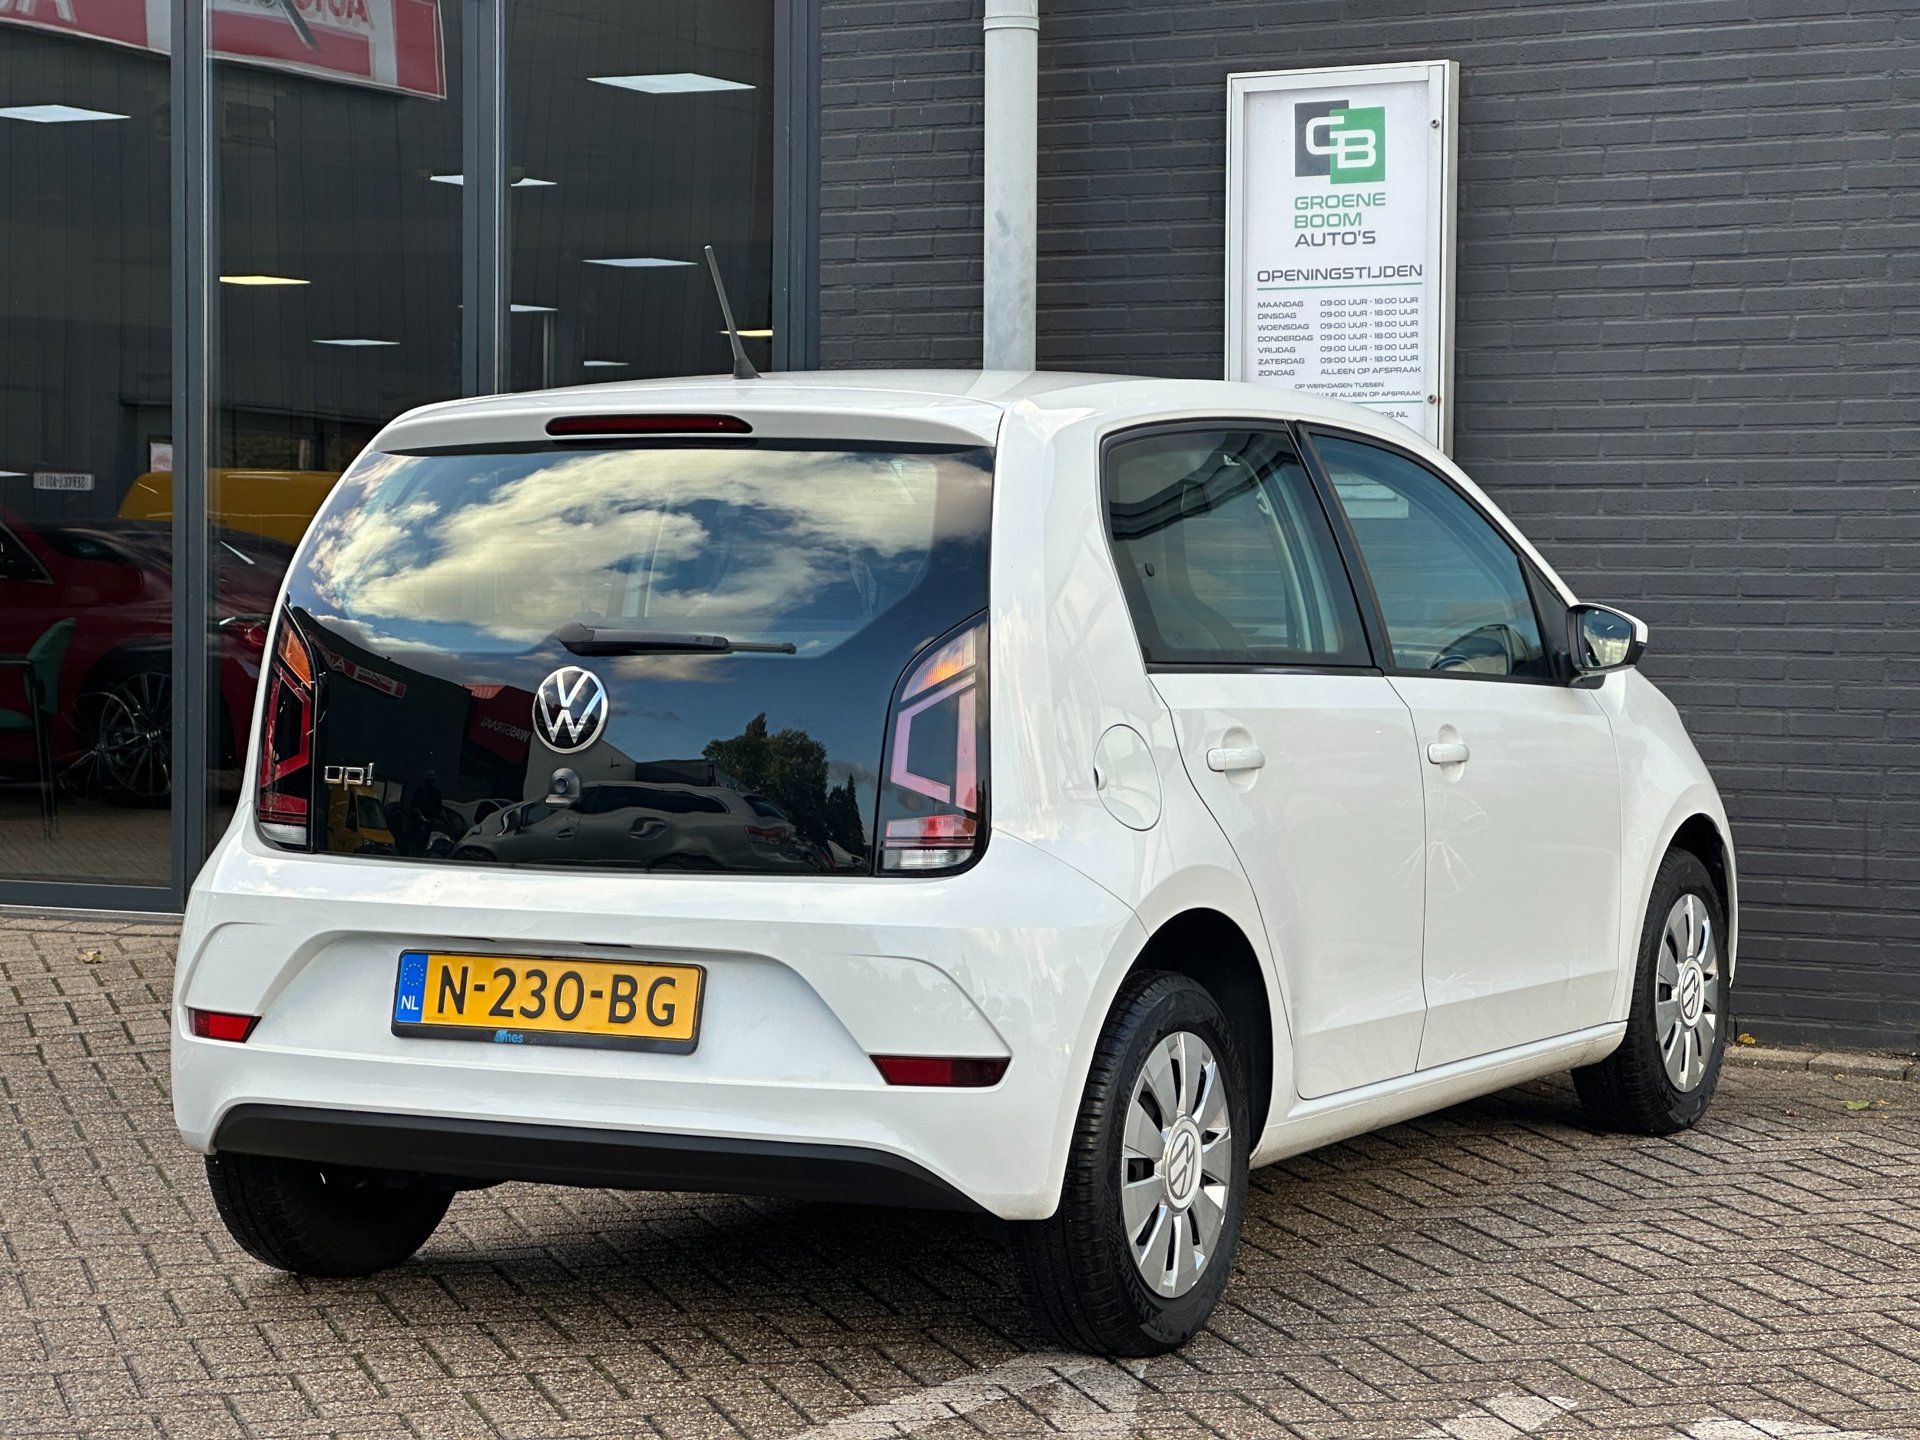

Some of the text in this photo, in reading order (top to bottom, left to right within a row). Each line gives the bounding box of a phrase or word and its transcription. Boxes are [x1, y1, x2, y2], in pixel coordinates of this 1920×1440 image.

[1295, 192, 1386, 210] GROENE
[1295, 212, 1361, 228] BOOM
[1295, 231, 1375, 247] AUTO'S
[1257, 264, 1422, 282] OPENINGSTIJDEN
[1348, 298, 1368, 306] UUR
[1258, 312, 1296, 320] DINSDAG
[1258, 323, 1309, 331] WOENSDAG
[1372, 366, 1421, 374] AFSPRAAK
[324, 763, 375, 790] up!
[401, 995, 419, 1010] NL
[438, 965, 676, 1026] N-230-BG
